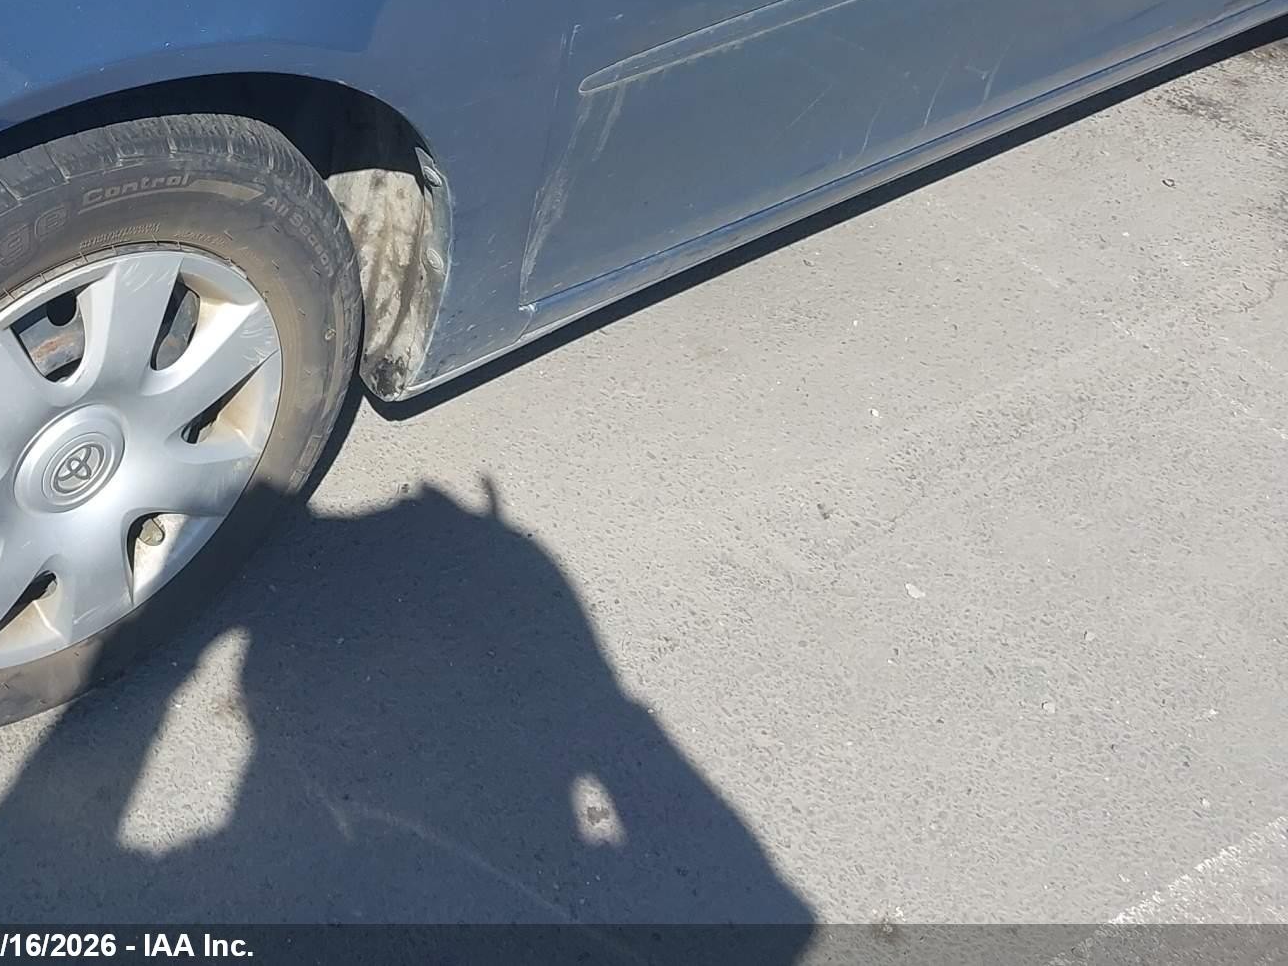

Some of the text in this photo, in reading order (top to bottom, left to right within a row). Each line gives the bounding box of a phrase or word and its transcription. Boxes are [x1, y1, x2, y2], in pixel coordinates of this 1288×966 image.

[80, 173, 191, 207] Control
[263, 194, 289, 217] All
[288, 212, 335, 278] Season
